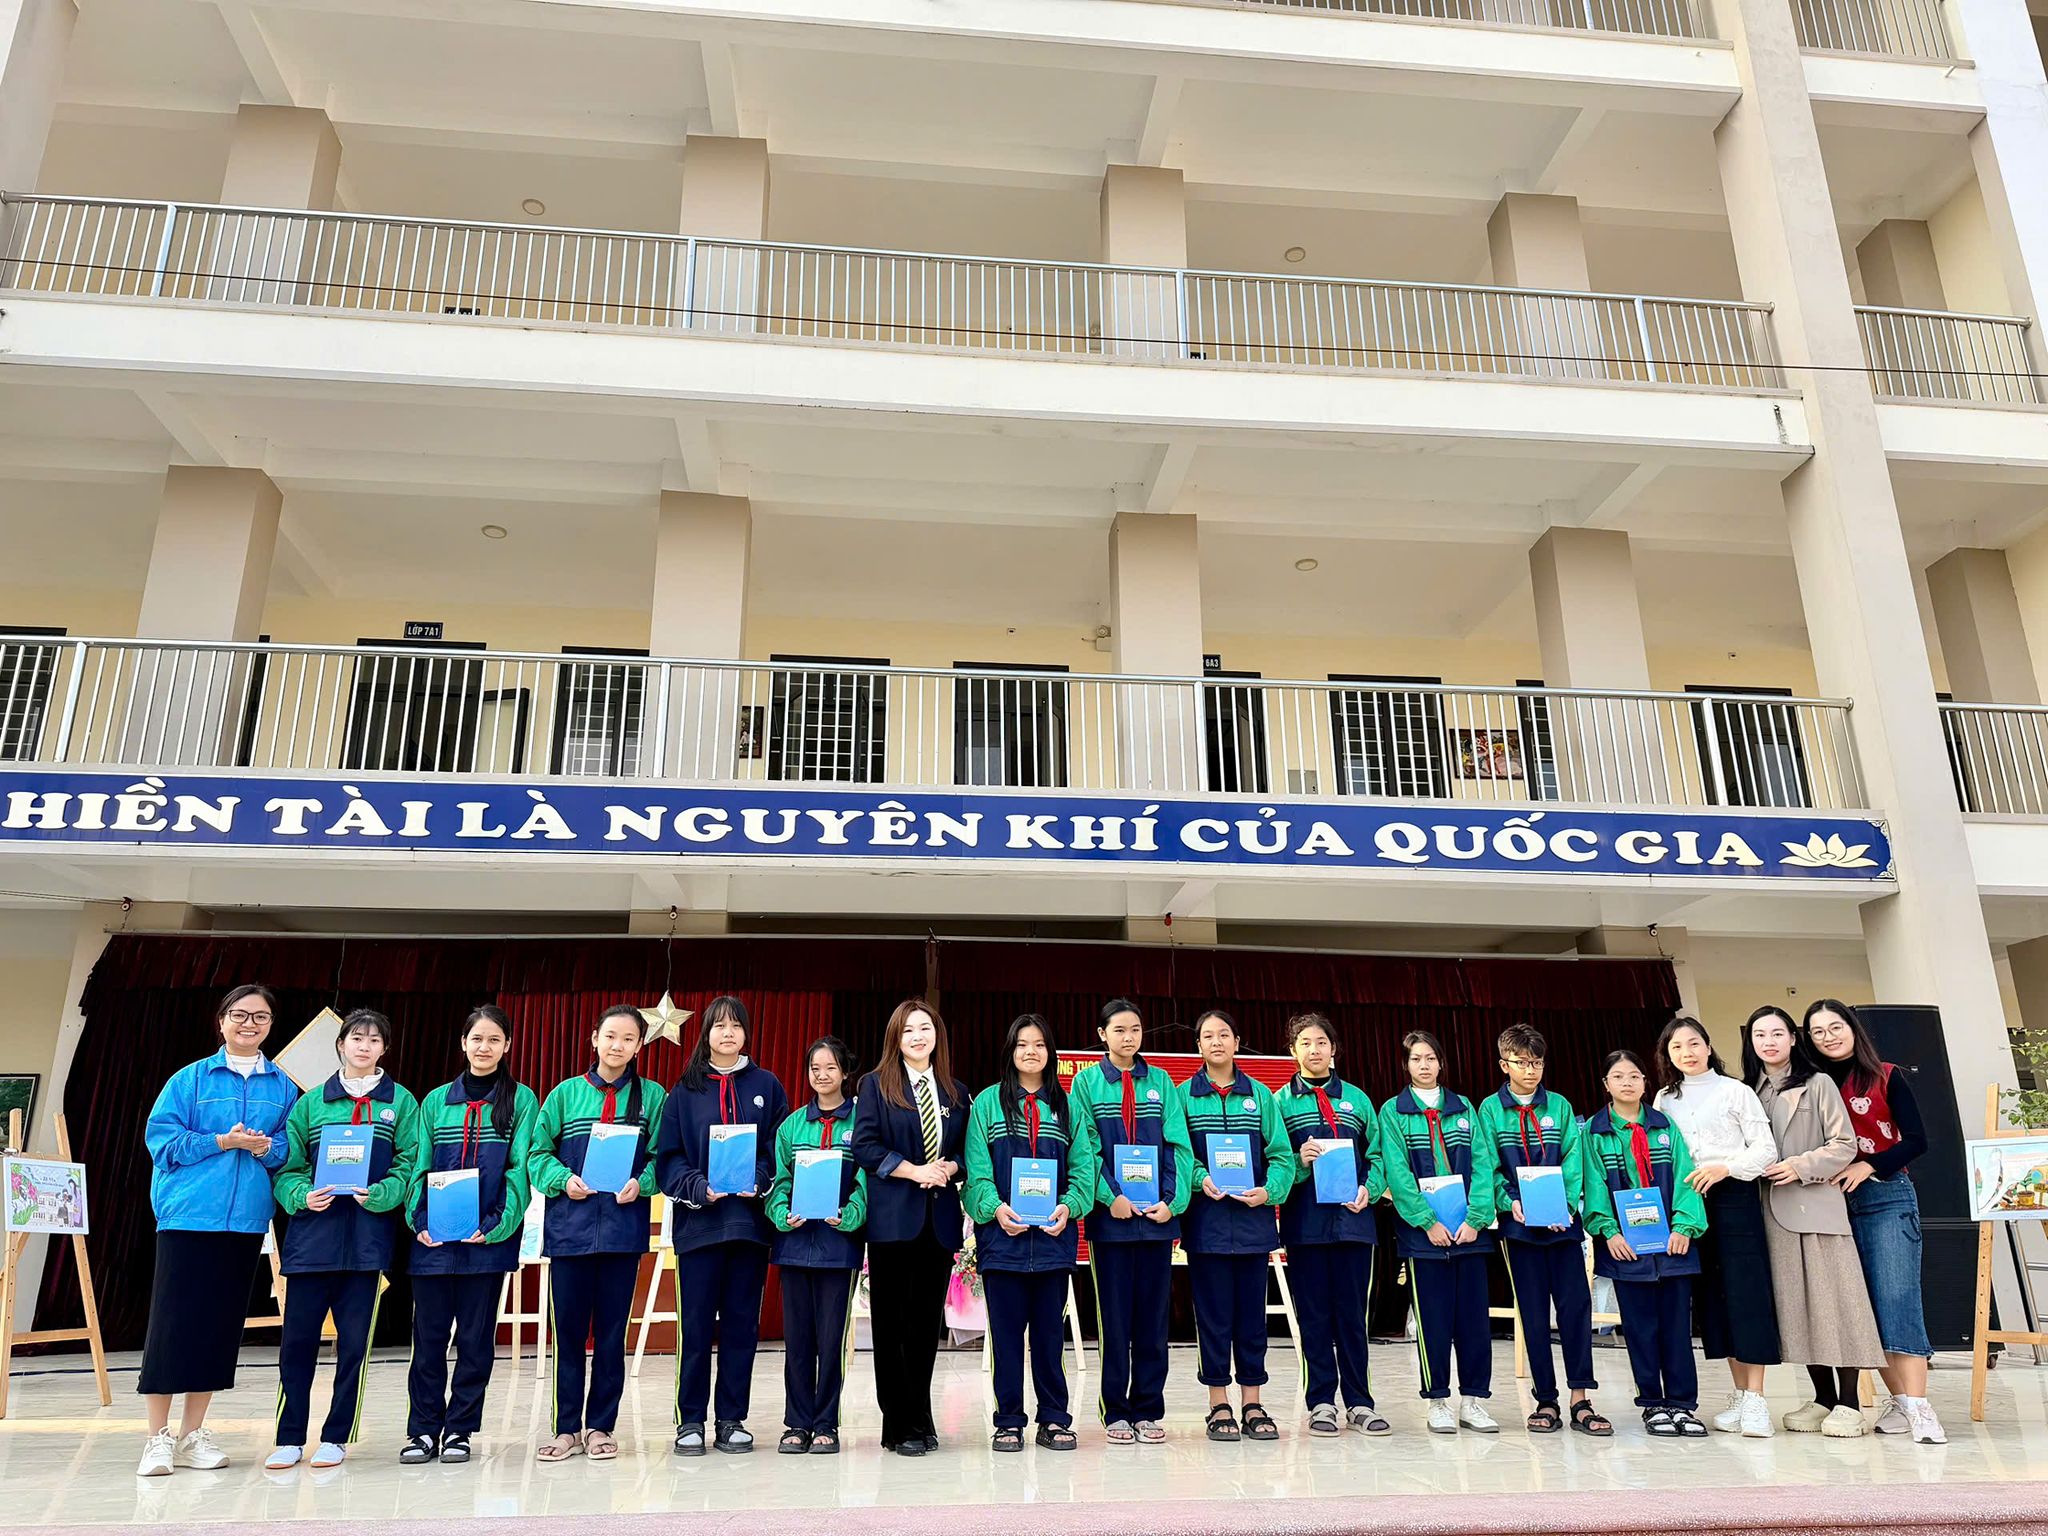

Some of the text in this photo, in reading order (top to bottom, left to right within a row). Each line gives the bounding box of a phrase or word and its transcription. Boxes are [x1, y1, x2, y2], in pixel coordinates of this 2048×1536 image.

[407, 623, 439, 636] LỚP 7A1
[1205, 658, 1219, 668] 6A3
[2, 777, 1764, 866] HIỀN TÀI LÀ NGUYÊN KHÍ CỦA QUỐC GIA
